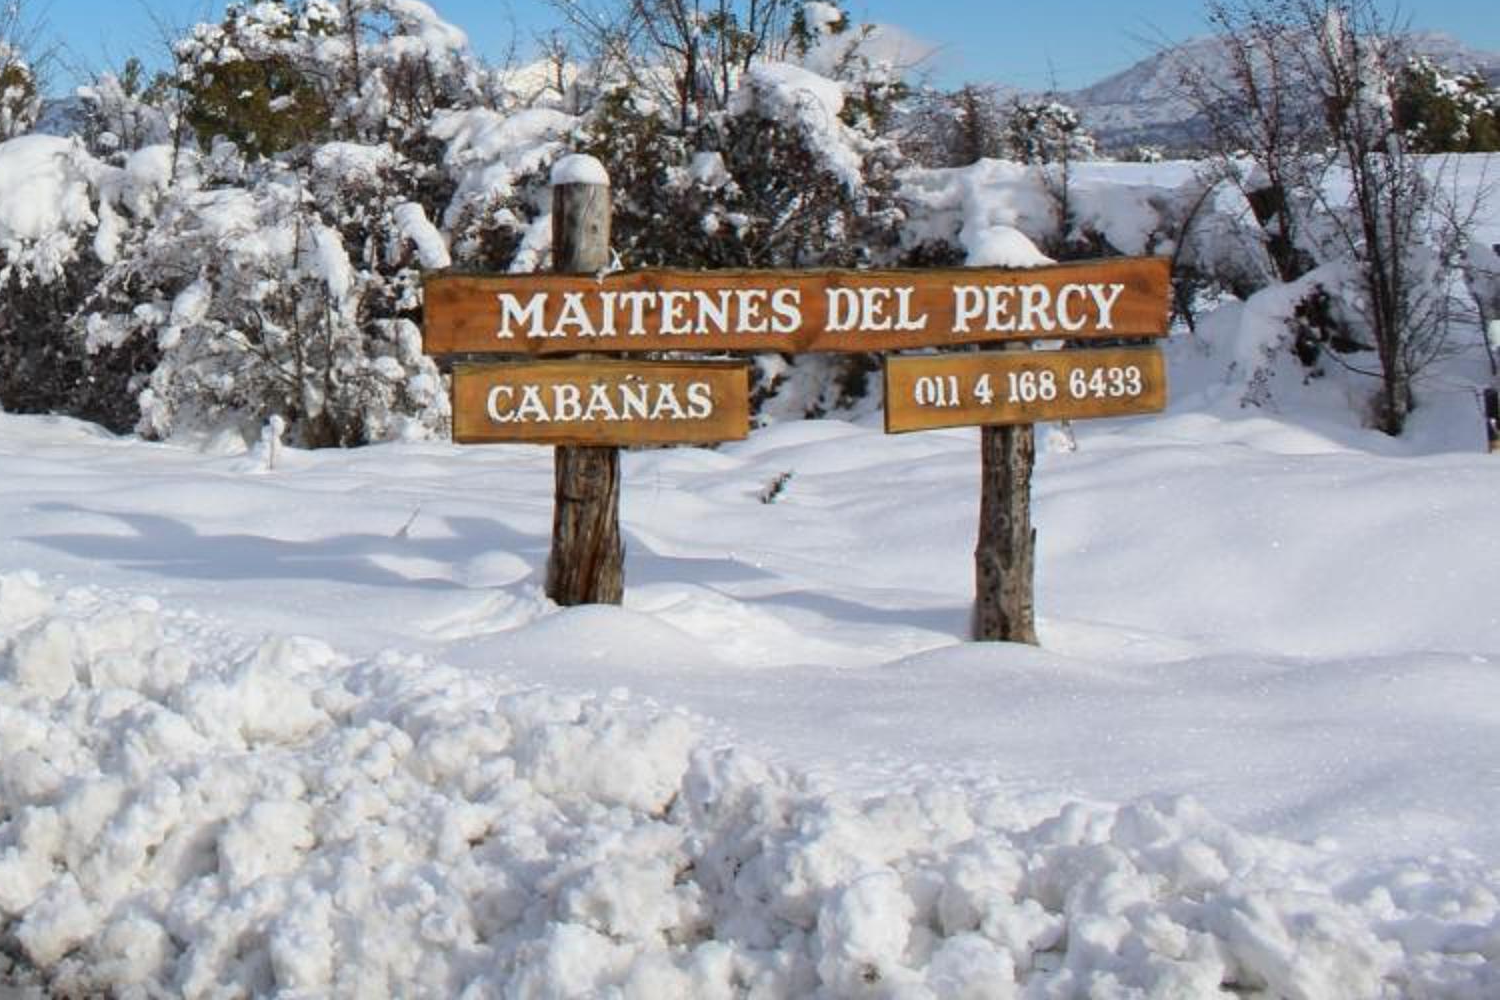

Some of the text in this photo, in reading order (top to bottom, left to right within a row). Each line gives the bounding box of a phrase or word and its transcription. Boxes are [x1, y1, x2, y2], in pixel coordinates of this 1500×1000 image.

[496, 283, 1125, 338] MAITENES DEL PERCY
[486, 374, 713, 423] CABAÑAS
[914, 365, 1142, 406] 011 4 168 6433
